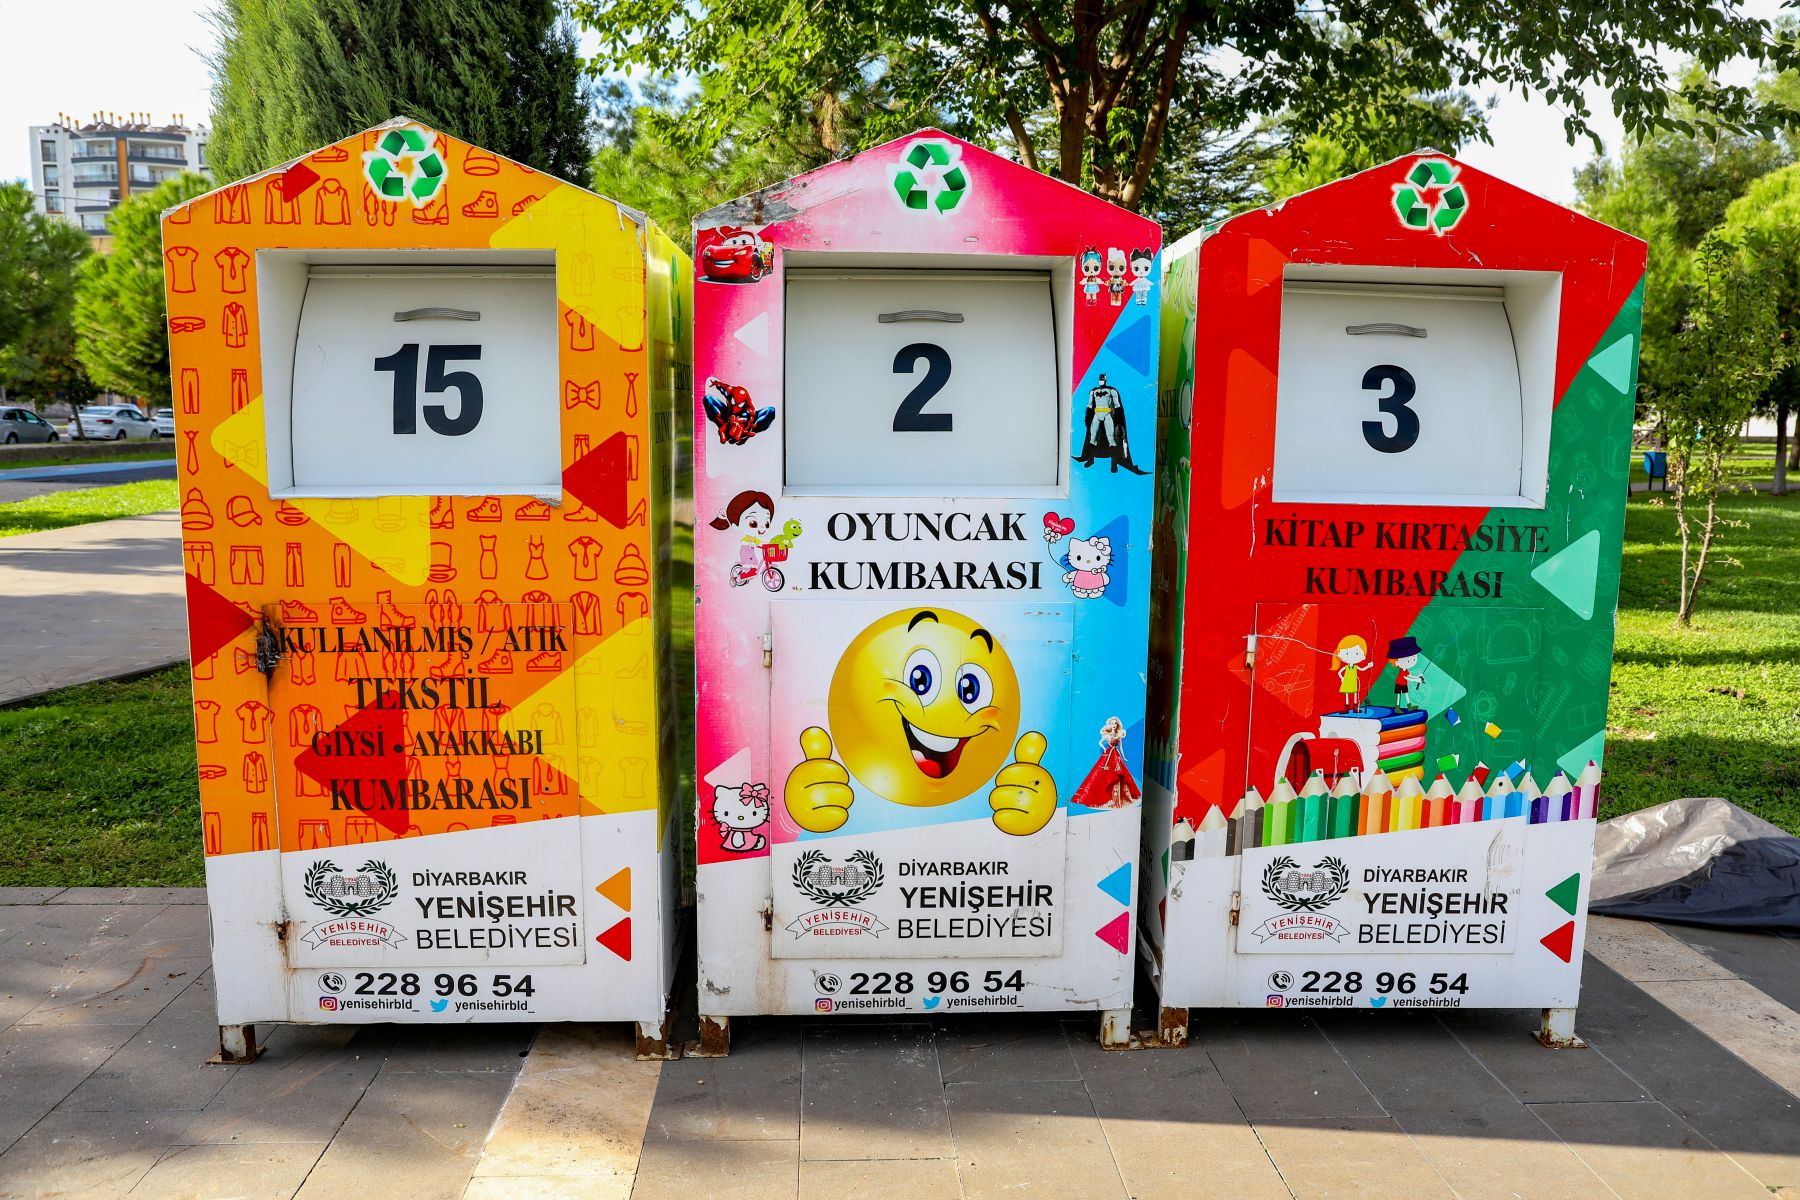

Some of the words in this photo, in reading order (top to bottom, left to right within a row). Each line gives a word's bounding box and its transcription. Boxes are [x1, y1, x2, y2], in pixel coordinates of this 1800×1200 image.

[374, 344, 483, 436] 15
[893, 343, 952, 432] 2
[1362, 365, 1419, 453] 3
[828, 513, 1027, 542] OYUNCAK
[1264, 513, 1365, 547] KİTAP
[1375, 518, 1549, 552] KIRTASİYE
[808, 562, 1042, 590] KUMBARASI
[1304, 568, 1505, 599] KUMBARASI
[277, 627, 473, 660] KULLANILMIŞ
[503, 626, 568, 651] ATIK
[349, 669, 502, 709] TEKSTİL
[312, 725, 385, 756] GİYSİ
[411, 730, 543, 755] AYAKKABI
[330, 777, 532, 810] KUMBARASI
[413, 868, 527, 887] DİYARBAKIR
[899, 859, 1008, 876] DİYARBAKIR
[1364, 866, 1467, 883] DİYARBAKIR
[414, 889, 577, 923] YENİŞEHİR
[900, 880, 1053, 913] YENİŞEHİR
[320, 920, 388, 936] YENİŞEHİR
[806, 910, 870, 926] YENİŞEHİR
[898, 912, 1051, 939] BELEDİYESİ
[1271, 915, 1333, 930] YENİŞEHİR
[329, 938, 380, 946] BELEDİYESİ
[417, 923, 577, 949] BELEDİYESİ
[813, 927, 862, 936] BELEDİYESİ
[1278, 931, 1325, 940] BELEDİYESİ
[1359, 920, 1505, 944] BELEDİYESİ
[355, 973, 420, 996] 228
[434, 974, 477, 996] 96
[492, 975, 535, 997] 54
[850, 972, 913, 994] 228
[928, 971, 970, 993] 96
[984, 970, 1025, 993] 54
[1301, 971, 1362, 993] 228
[1376, 972, 1416, 994] 96
[1429, 973, 1469, 994] 54
[340, 999, 420, 1013] yenisehirbld_
[455, 1000, 535, 1013] yenisehirbld_
[835, 997, 913, 1011] yenisehirbld_
[947, 996, 1024, 1009] yenisehirbld_
